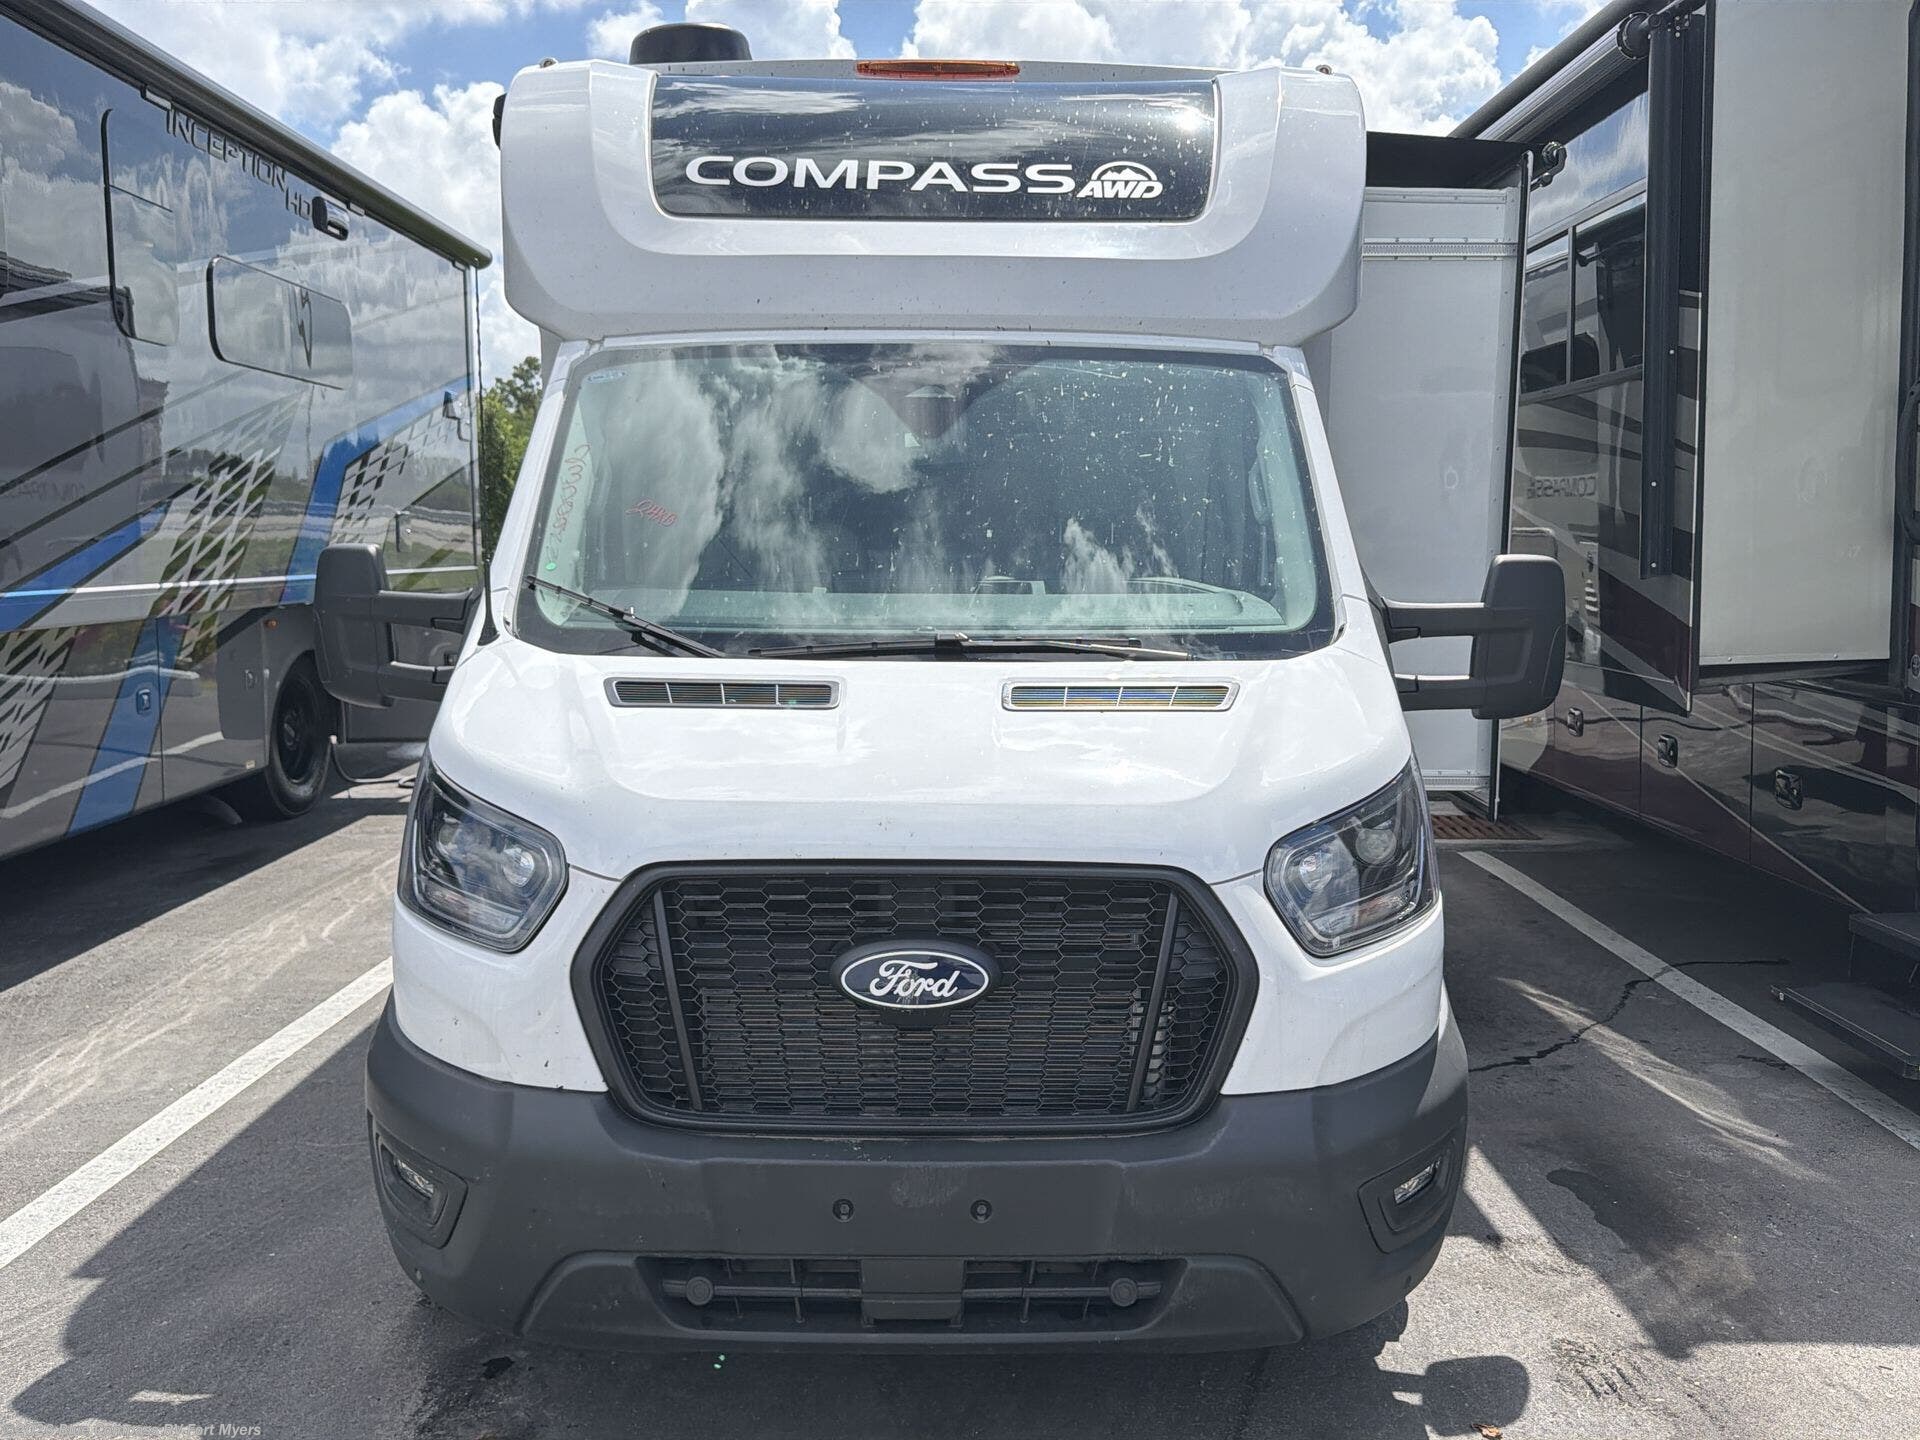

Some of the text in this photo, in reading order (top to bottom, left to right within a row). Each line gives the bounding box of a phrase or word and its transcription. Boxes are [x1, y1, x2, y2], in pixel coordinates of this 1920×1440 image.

[164, 105, 312, 220] INCEPTION HD
[685, 156, 1164, 199] COMPASS AWD
[869, 959, 961, 997] Ford
